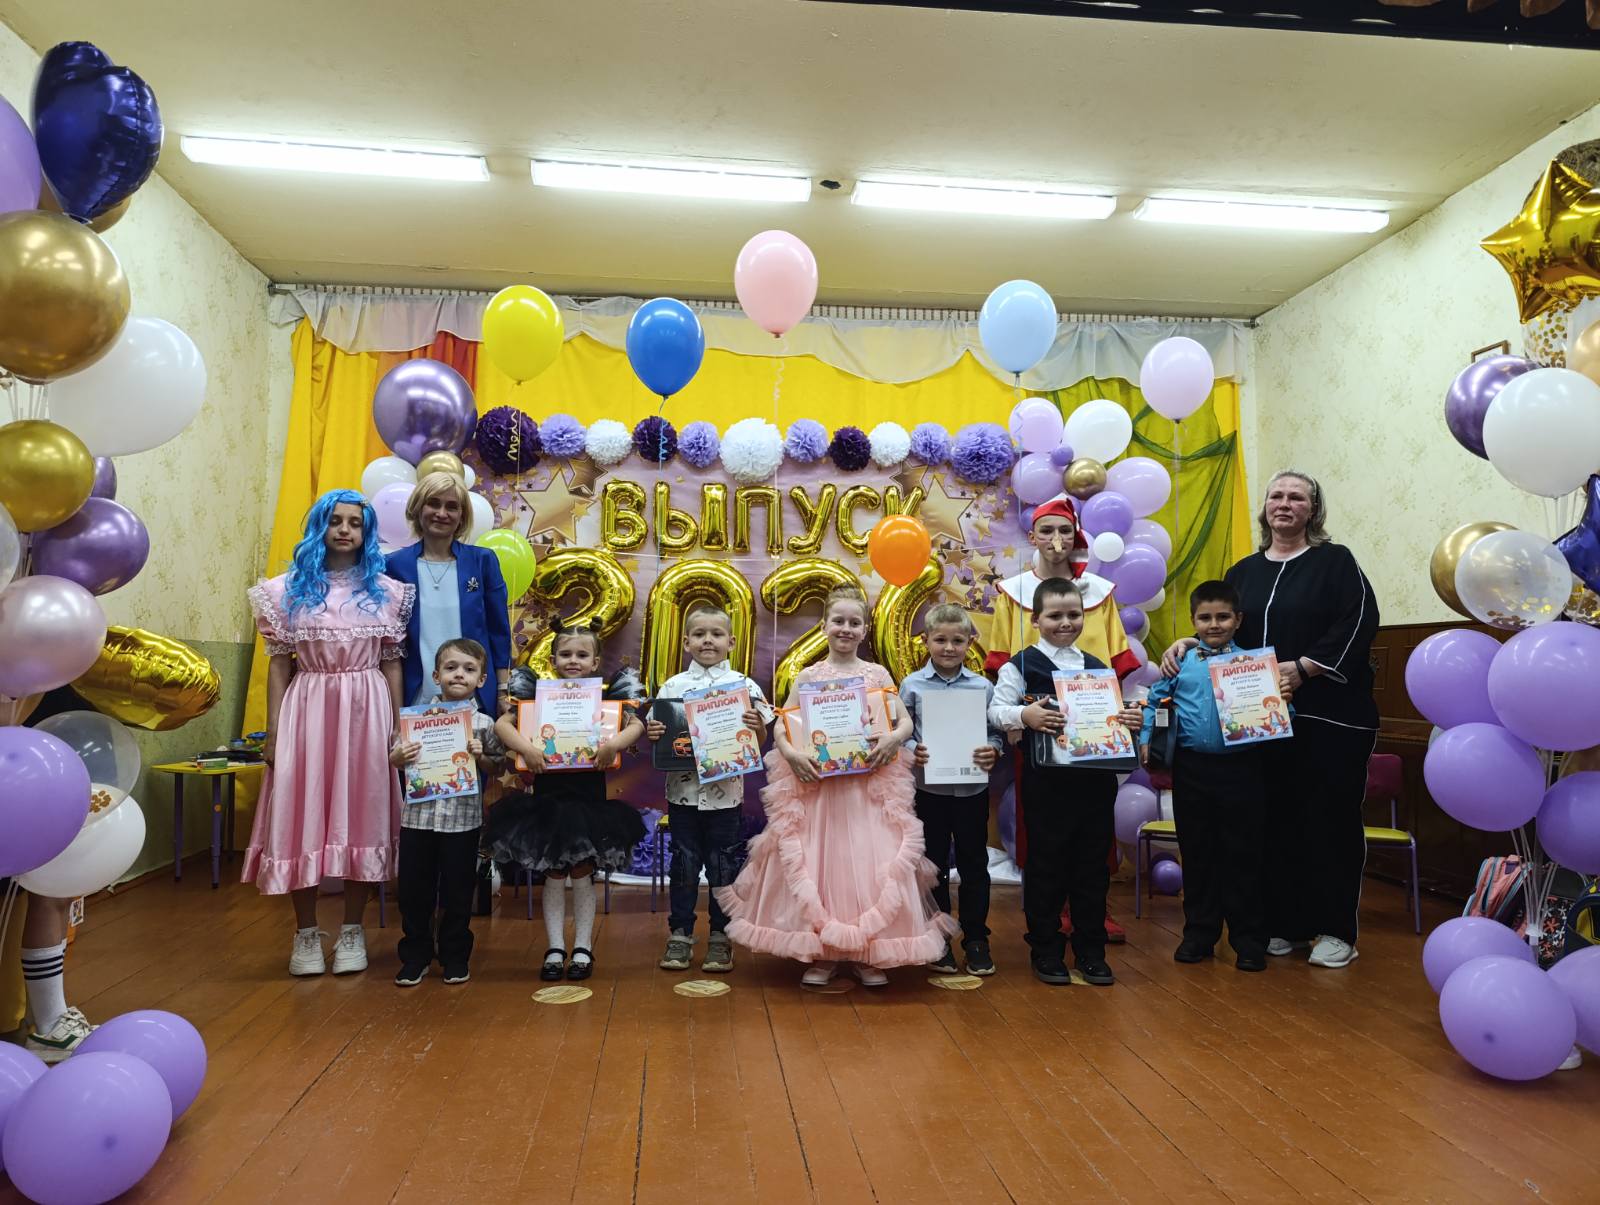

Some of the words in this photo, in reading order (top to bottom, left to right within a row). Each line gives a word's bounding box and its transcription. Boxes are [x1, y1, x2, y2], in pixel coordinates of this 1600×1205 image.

[1222, 663, 1266, 677] ДИПЛОМ
[547, 692, 592, 701] ДИПЛОМ
[812, 692, 856, 706] ДИПЛОМ
[696, 696, 740, 713] ДИПЛОМ
[413, 716, 460, 731] ДИПЛОМ
